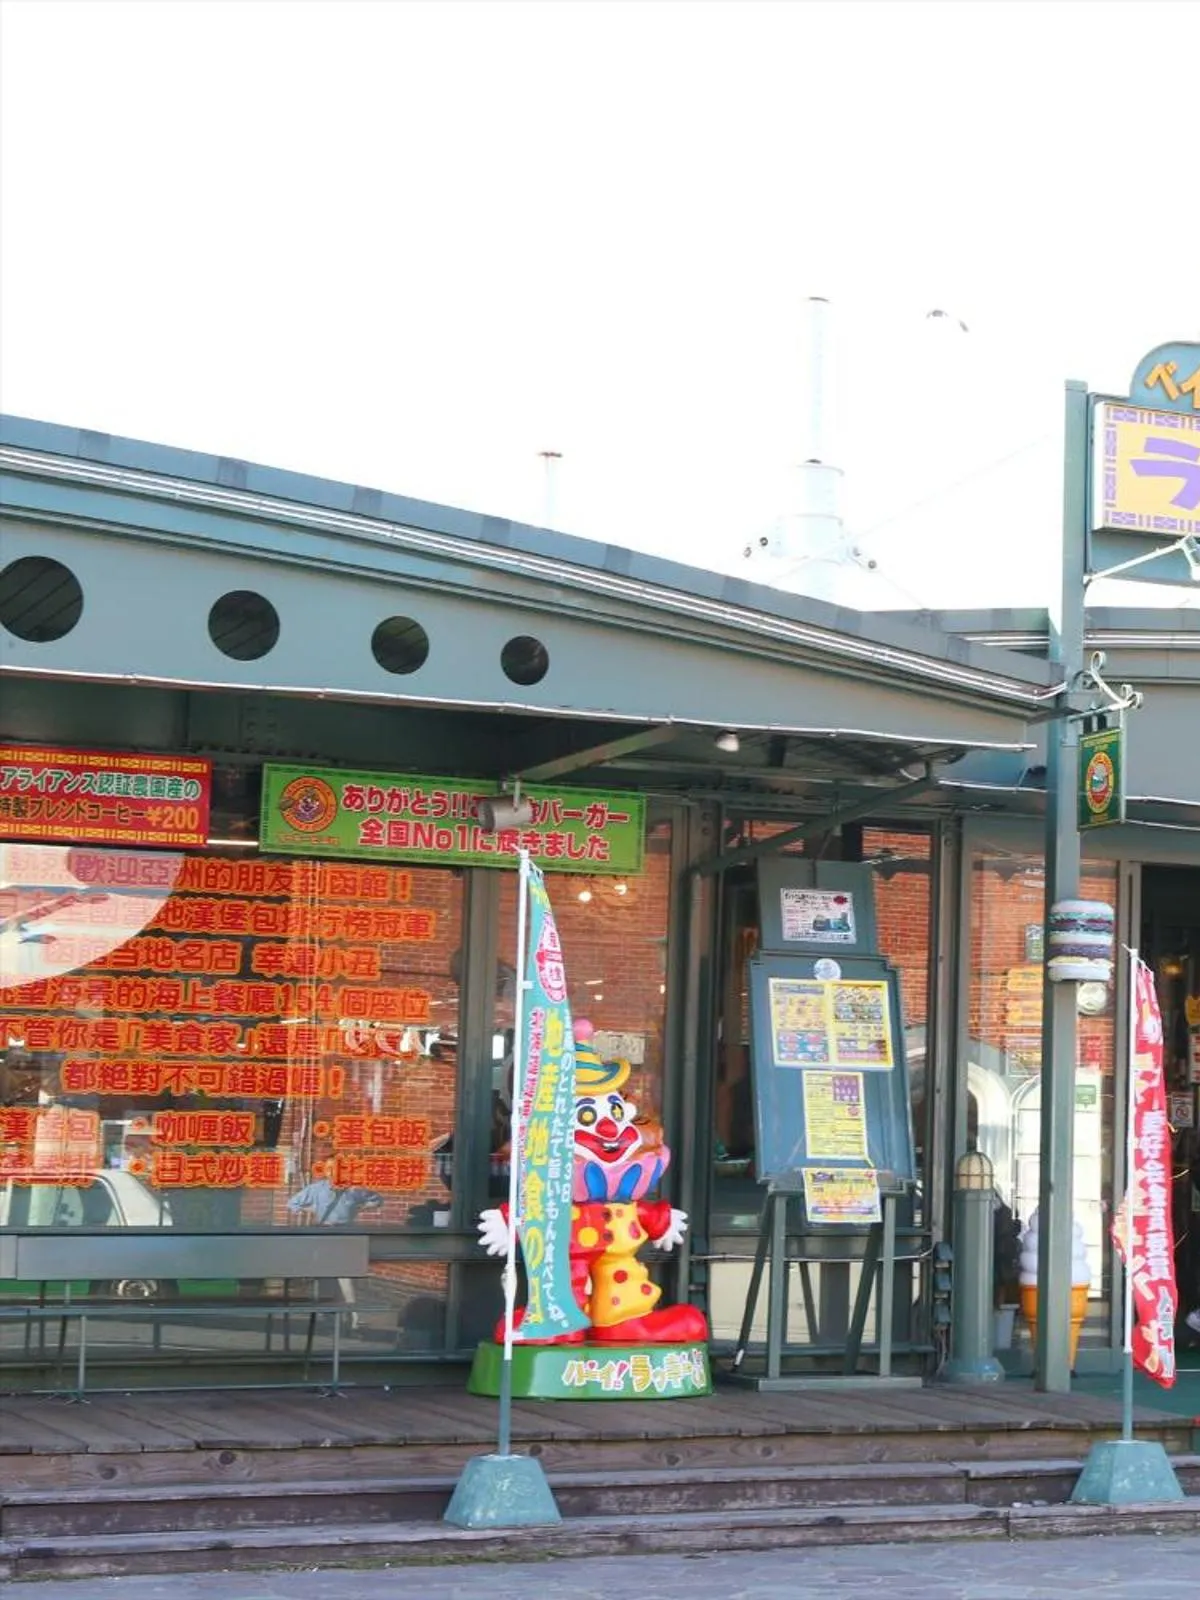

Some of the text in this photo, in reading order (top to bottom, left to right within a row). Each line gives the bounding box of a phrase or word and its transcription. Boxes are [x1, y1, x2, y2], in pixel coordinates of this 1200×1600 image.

[147, 806, 200, 830] ¥200
[341, 784, 632, 830] ありがとう!!バーガー
